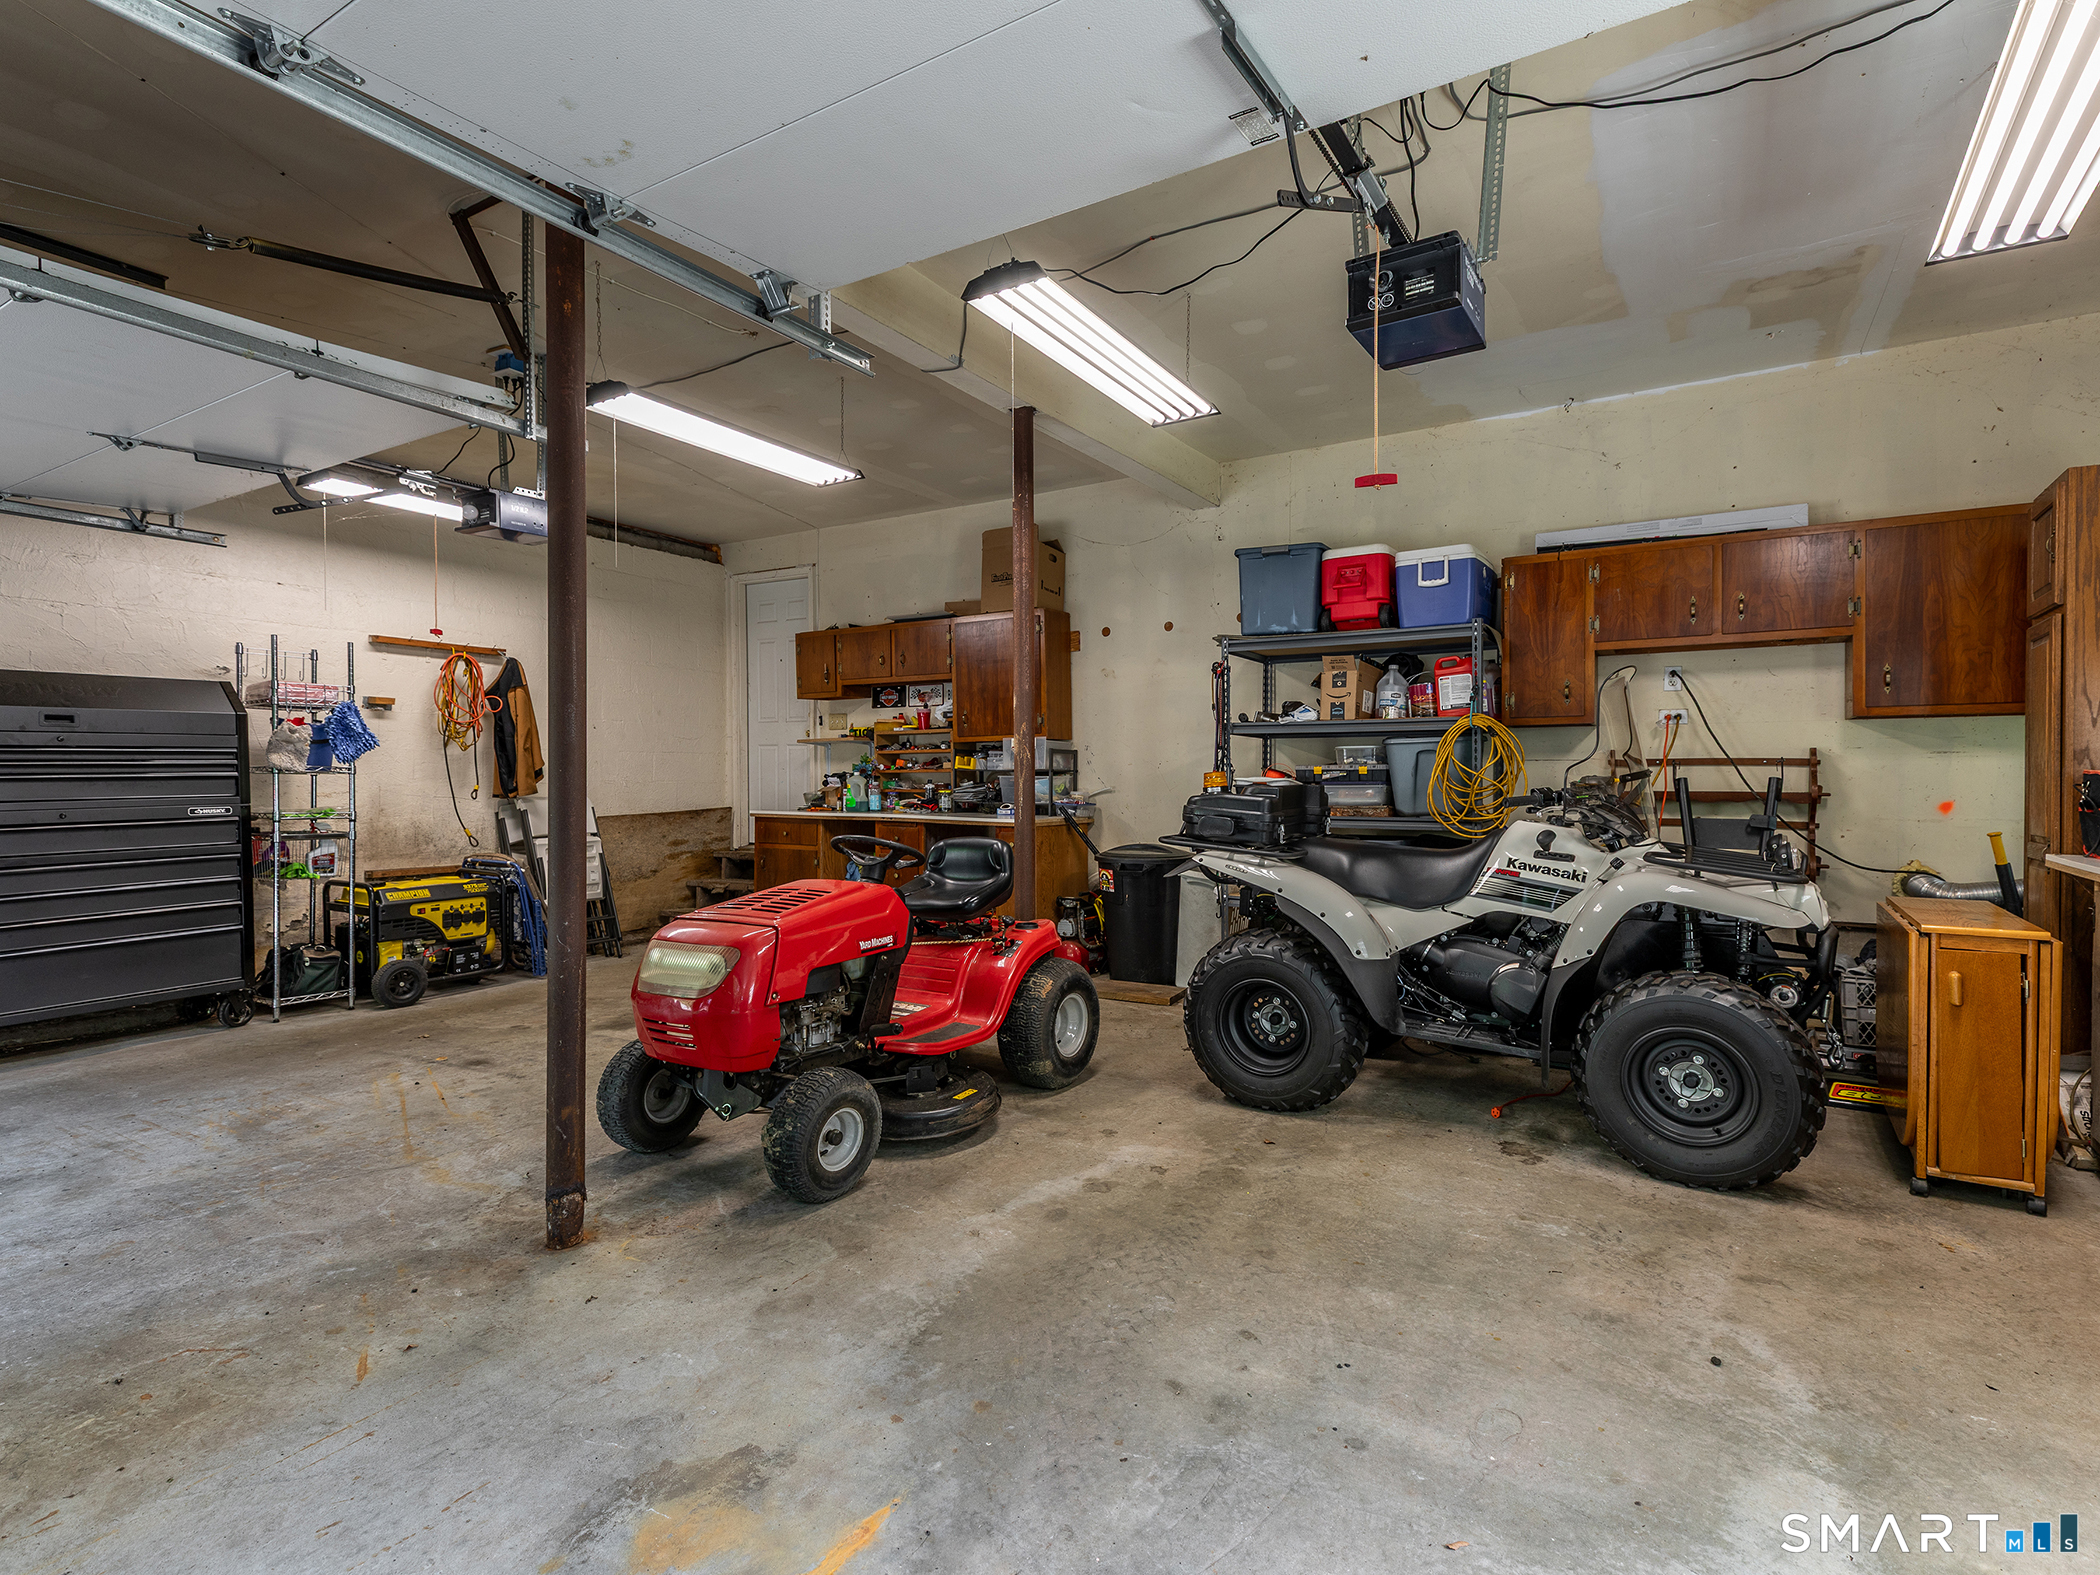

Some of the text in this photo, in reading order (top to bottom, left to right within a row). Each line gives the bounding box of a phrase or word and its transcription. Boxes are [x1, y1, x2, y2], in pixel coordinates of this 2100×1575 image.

[1506, 857, 1588, 883] Kawasaki
[385, 888, 431, 900] CHAMPION
[1753, 1070, 1788, 1158] DUNLOP
